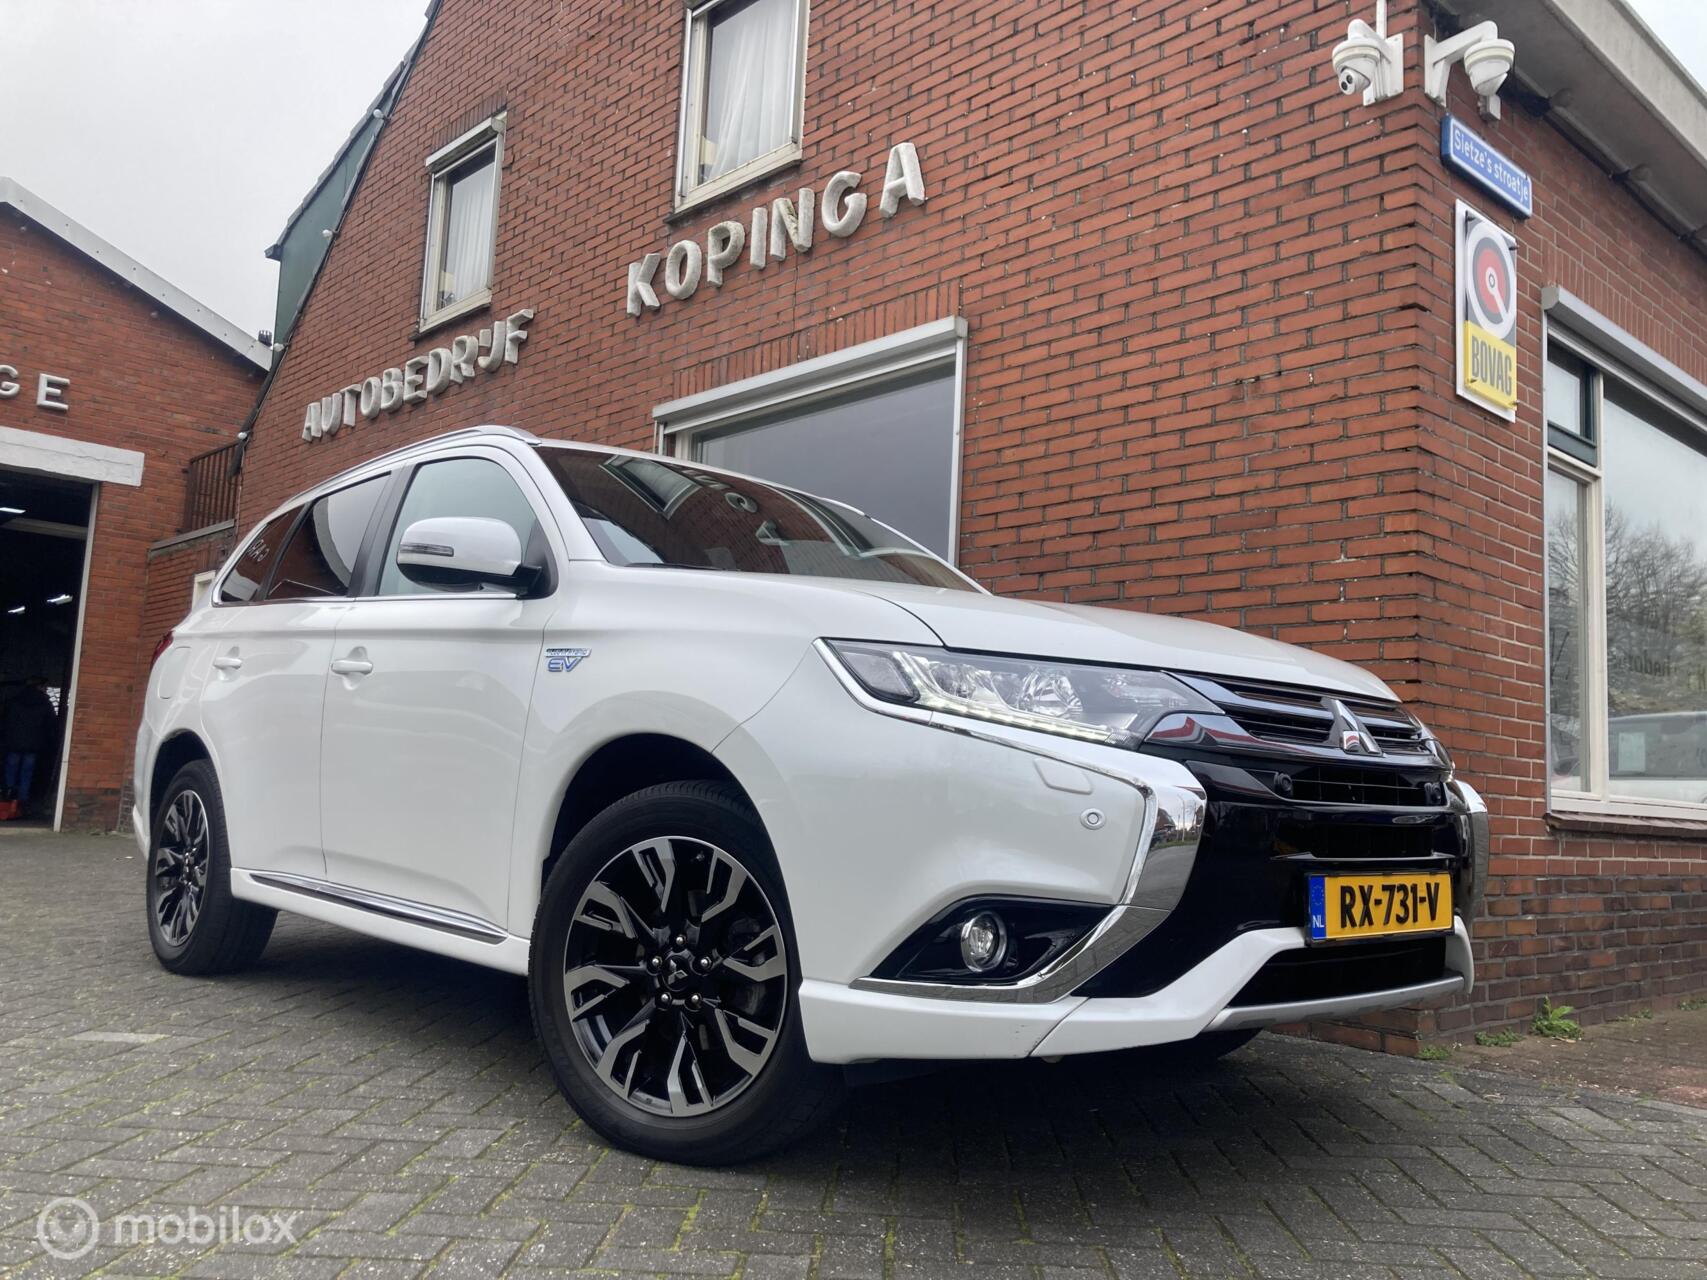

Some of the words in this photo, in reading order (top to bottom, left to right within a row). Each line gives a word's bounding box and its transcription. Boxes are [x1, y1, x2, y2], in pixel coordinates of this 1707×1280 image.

[1454, 129, 1492, 174] Sietze's
[1494, 161, 1528, 202] stroatje
[302, 308, 535, 442] AUTOBEDRIJF
[627, 142, 926, 317] KOPINGA
[1472, 335, 1512, 397] BOVAG
[547, 656, 583, 673] EV
[1312, 915, 1325, 928] NL
[1340, 882, 1440, 929] RX-731-V
